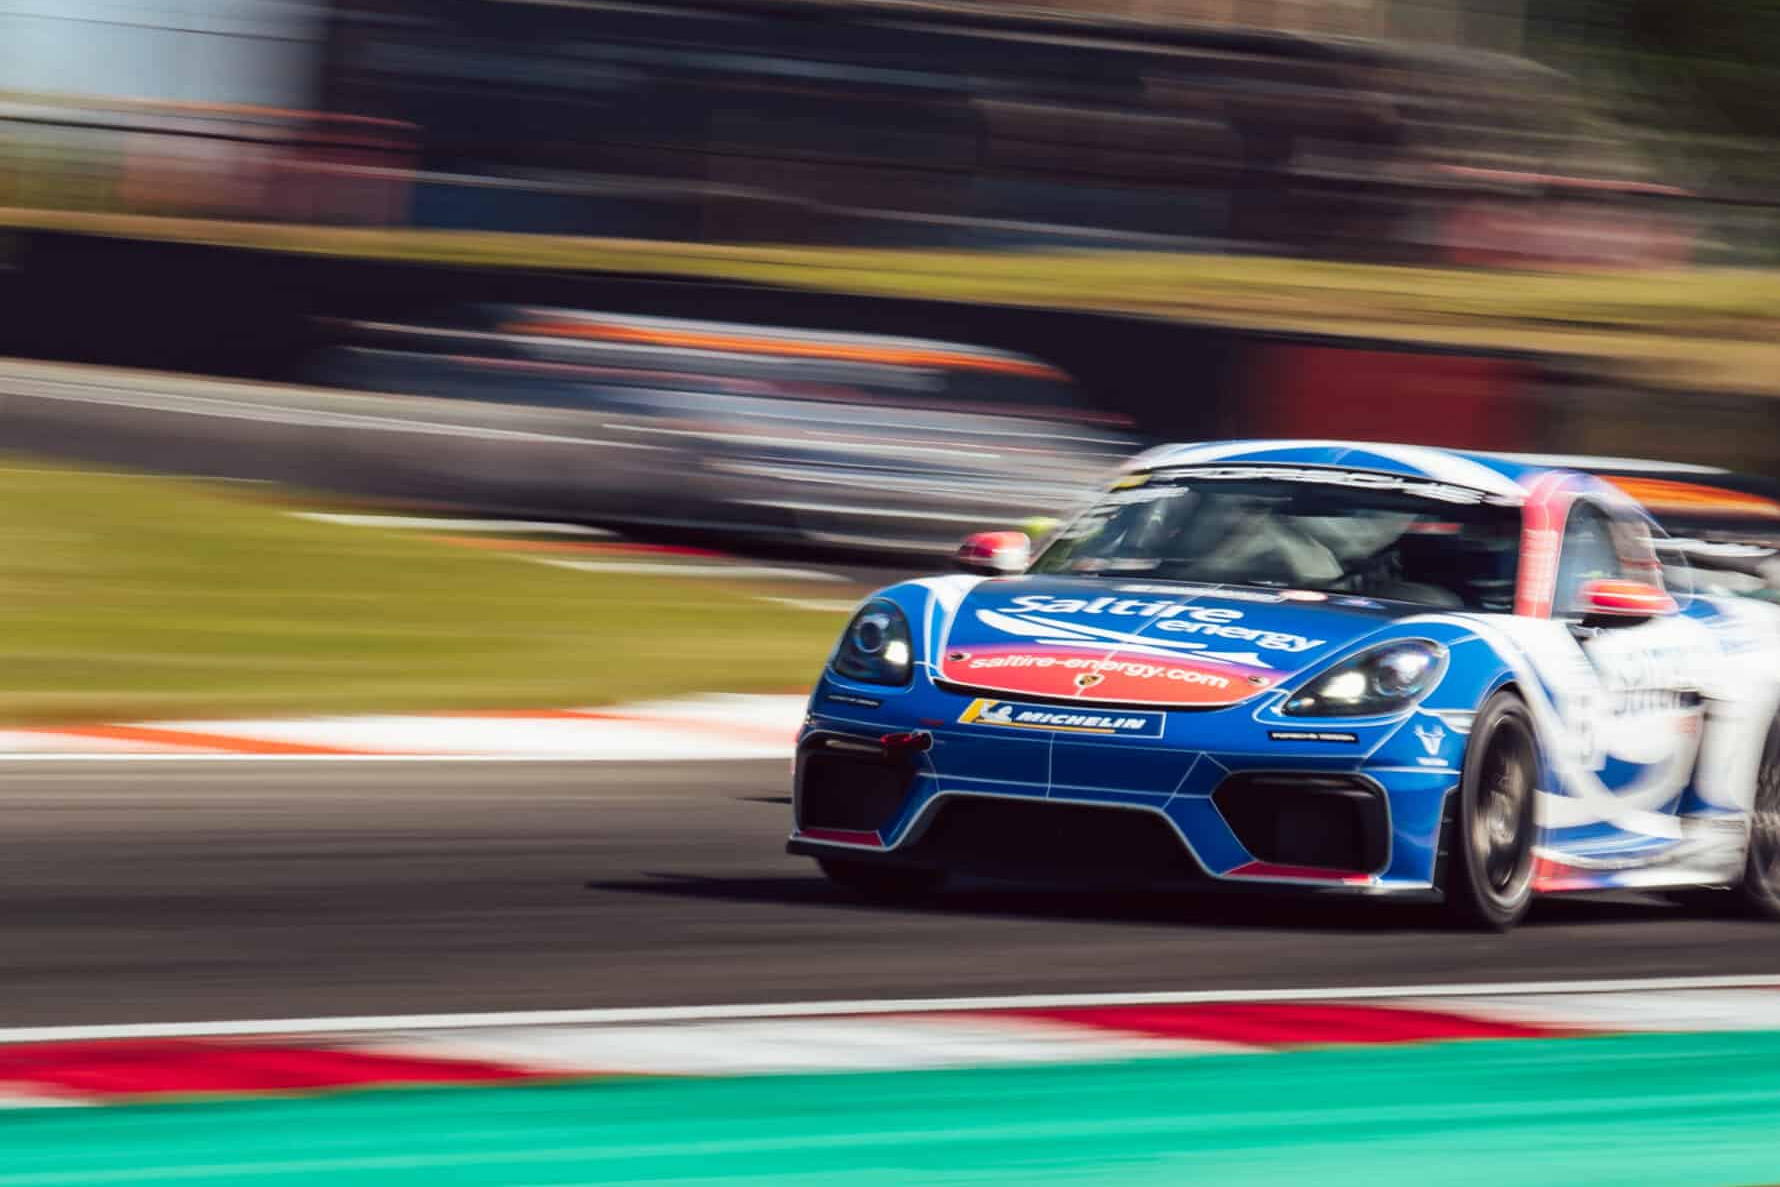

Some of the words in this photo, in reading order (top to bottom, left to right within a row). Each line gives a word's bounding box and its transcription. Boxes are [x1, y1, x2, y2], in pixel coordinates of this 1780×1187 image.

[1000, 595, 1244, 624] Saltire
[1156, 618, 1327, 653] energy
[969, 654, 1230, 689] saltire-energy.com
[1015, 710, 1147, 730] MICHELIN
